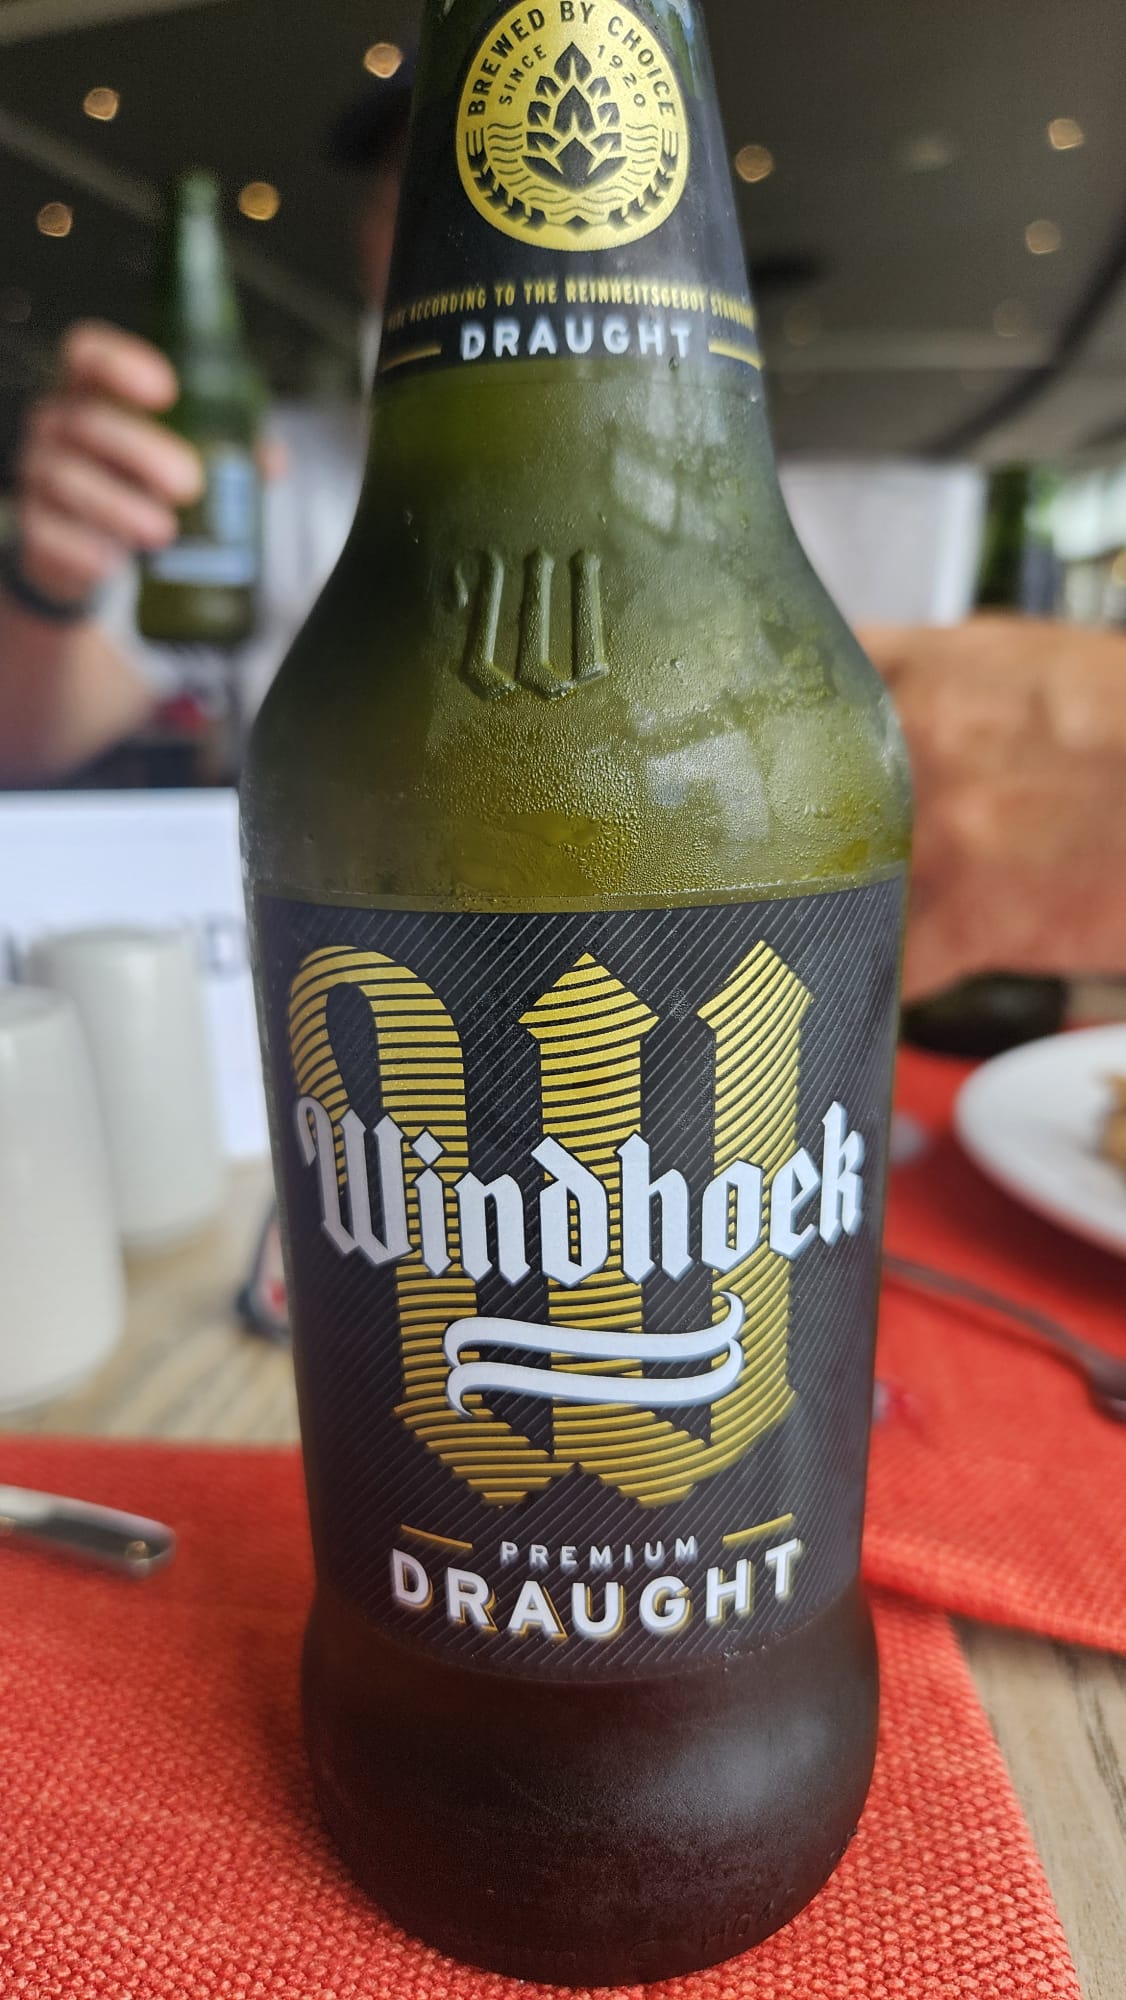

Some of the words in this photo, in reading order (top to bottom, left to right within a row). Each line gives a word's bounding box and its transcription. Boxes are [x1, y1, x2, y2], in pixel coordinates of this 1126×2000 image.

[467, 8, 545, 117] BREWED
[560, 0, 595, 24] BY
[607, 15, 676, 117] CHOICE
[499, 44, 547, 106] SINCE
[597, 44, 646, 108] 1920
[409, 286, 486, 322] ACCORDING
[494, 281, 516, 307] TO
[523, 276, 557, 304] THE
[460, 315, 692, 360] DRAUGHT
[296, 1099, 866, 1288] Windhoek
[501, 1534, 698, 1571] PREMIUM
[391, 1537, 802, 1640] DRAUGHT
